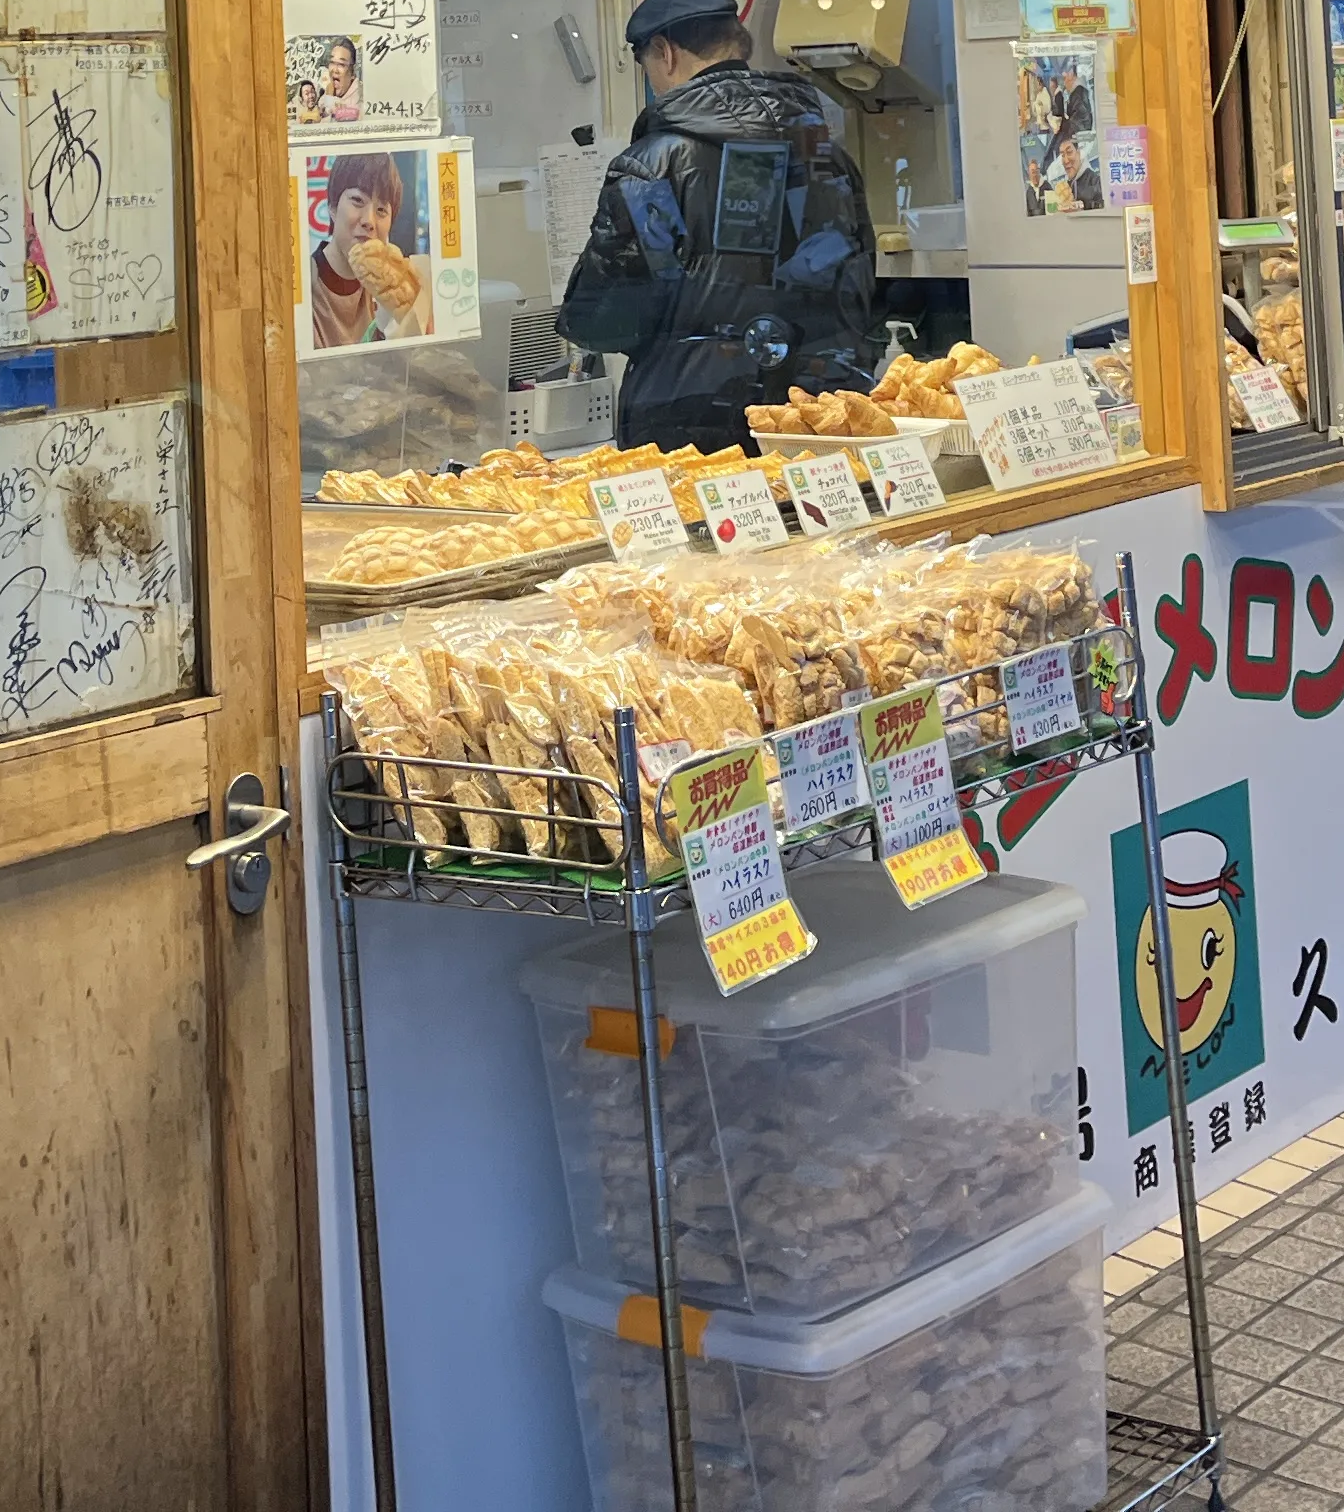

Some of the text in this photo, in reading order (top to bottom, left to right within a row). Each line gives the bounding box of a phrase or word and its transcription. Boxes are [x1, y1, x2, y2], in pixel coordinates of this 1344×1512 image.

[1109, 160, 1146, 183] 買物券
[440, 158, 457, 248] 大橋和也
[1003, 405, 1043, 426] 1個単品
[1009, 423, 1050, 445] 3個セット
[1017, 440, 1057, 464] 5個セット
[874, 697, 926, 737] お買得品
[688, 757, 749, 806] お買得品
[806, 764, 854, 792] ハイラスク
[800, 791, 838, 823] 260円
[898, 782, 934, 805] ハイラスク
[721, 858, 770, 892] ハイラスク
[728, 886, 764, 921] 640円
